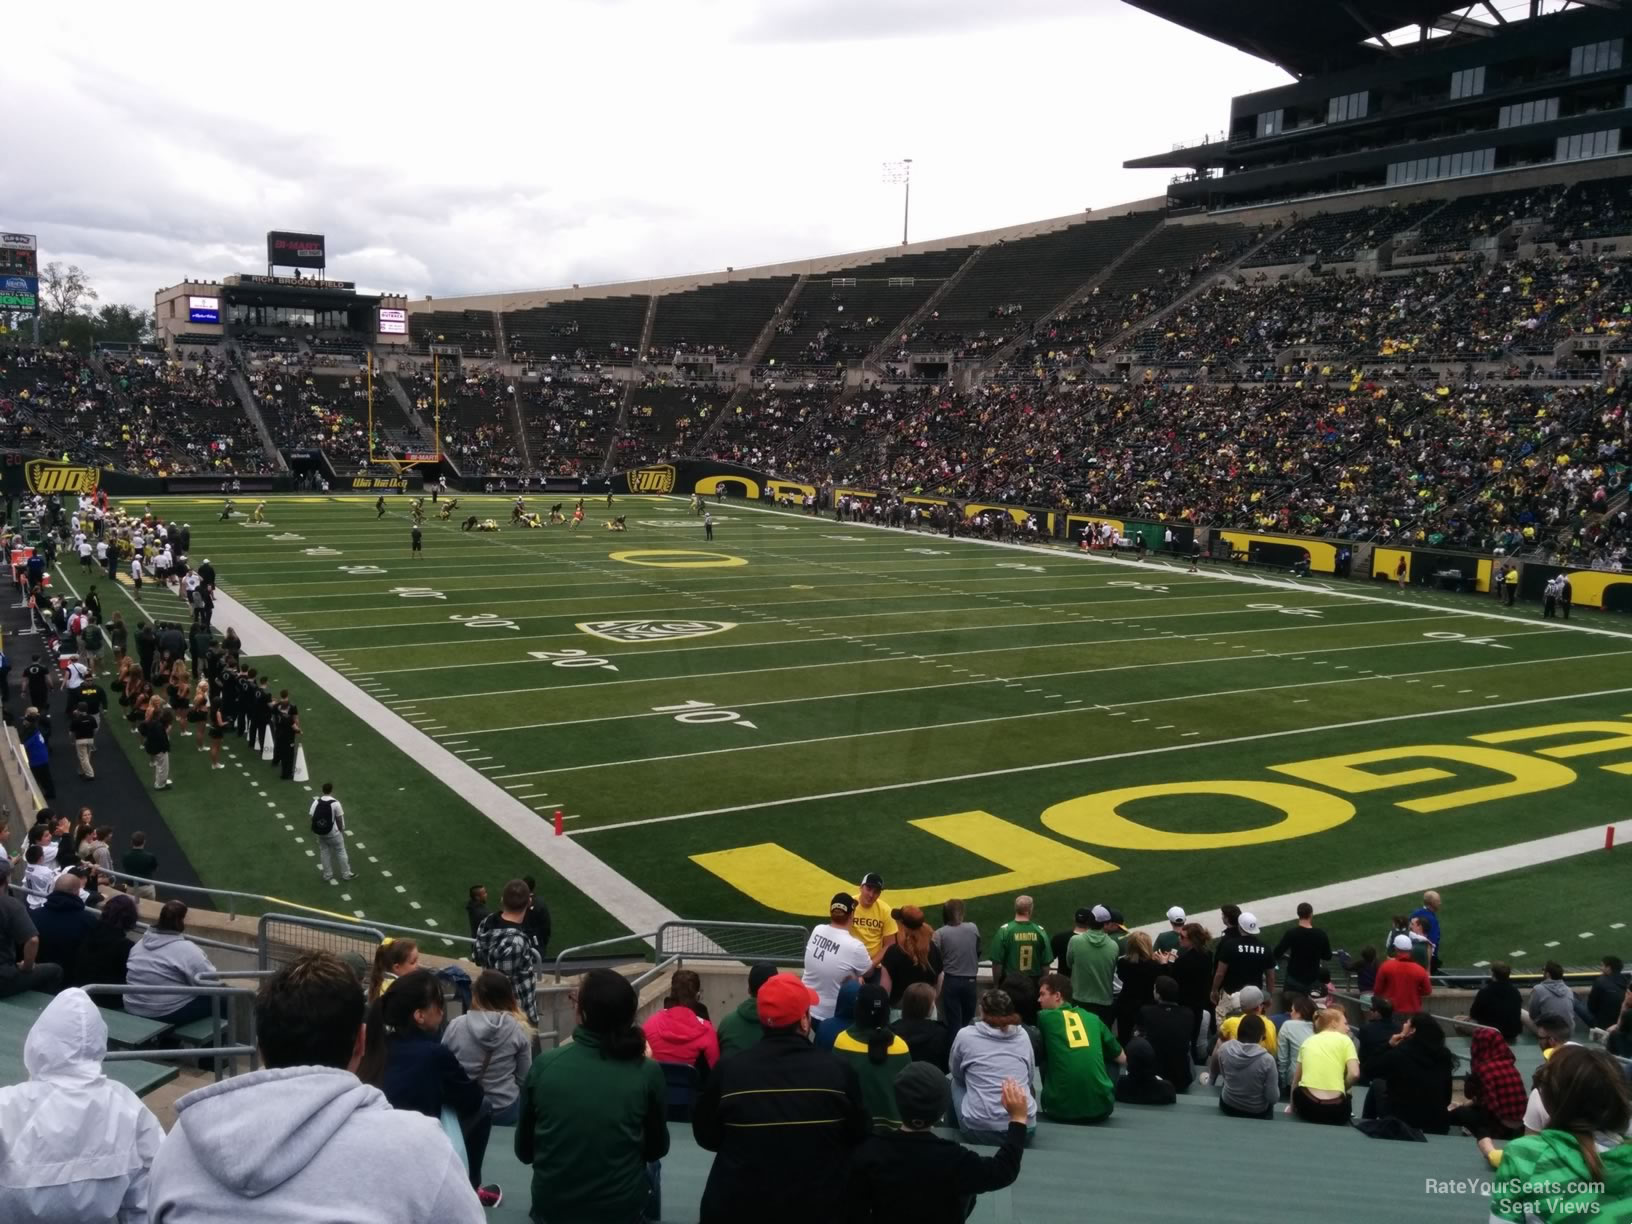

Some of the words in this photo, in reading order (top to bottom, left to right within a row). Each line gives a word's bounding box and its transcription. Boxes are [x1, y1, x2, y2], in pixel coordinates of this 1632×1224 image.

[252, 274, 274, 283] RICH
[278, 277, 316, 287] BROOKS
[320, 280, 345, 288] FIELD
[449, 613, 516, 627] 30
[527, 649, 610, 667] 20
[651, 700, 741, 723] 10
[852, 917, 885, 929] REGO
[812, 934, 840, 955] STORM
[1237, 944, 1265, 955] STAFF
[813, 948, 825, 962] LA
[1020, 945, 1033, 971] 8
[1062, 1009, 1090, 1048] 8
